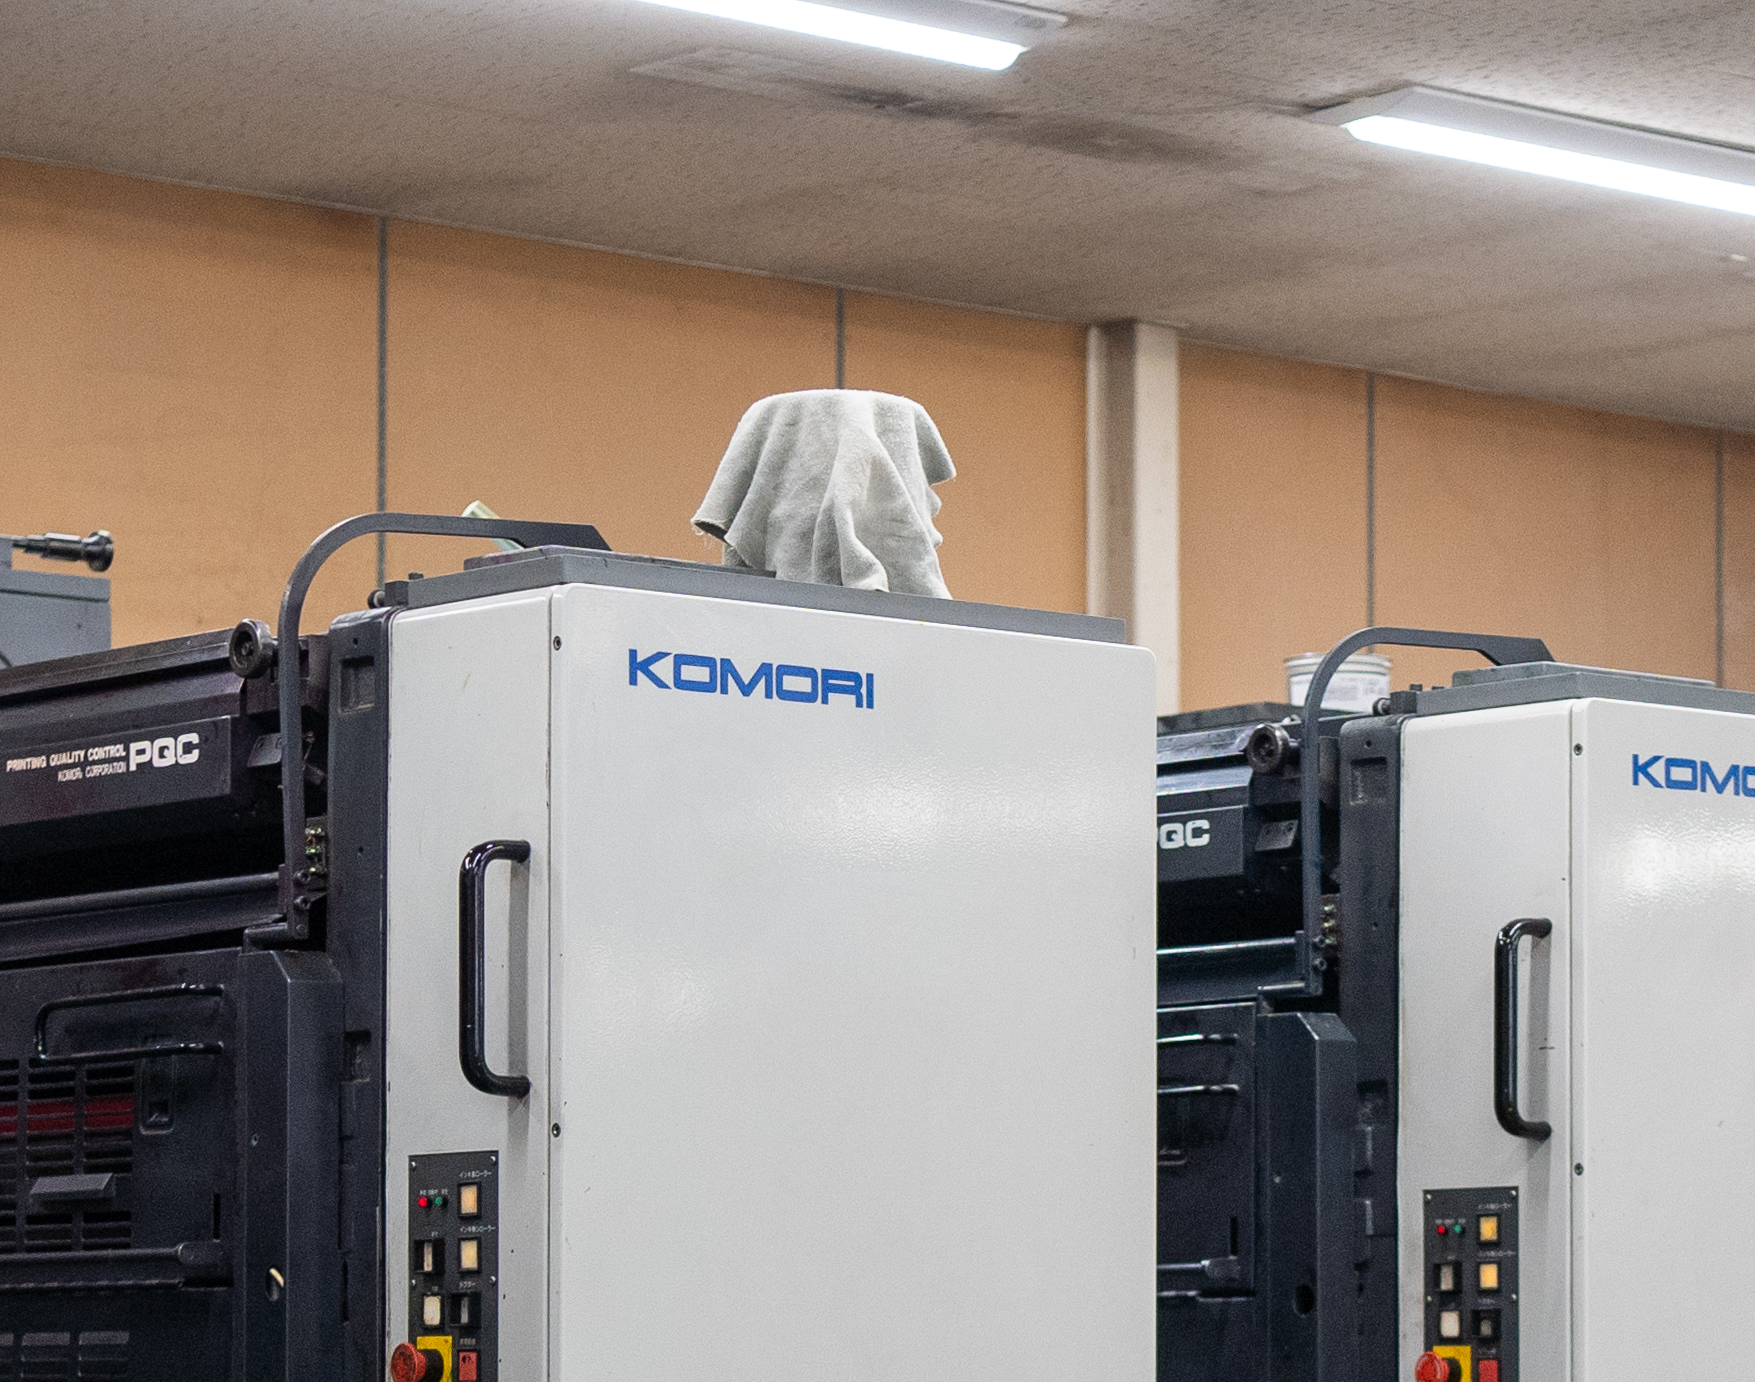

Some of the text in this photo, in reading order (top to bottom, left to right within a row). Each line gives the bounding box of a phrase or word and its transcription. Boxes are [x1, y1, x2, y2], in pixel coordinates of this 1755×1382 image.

[628, 648, 874, 710] KOMORI
[6, 743, 126, 773] PRINTING QUALITY CONTROL
[129, 732, 200, 772] PQC
[1157, 819, 1210, 850] QC
